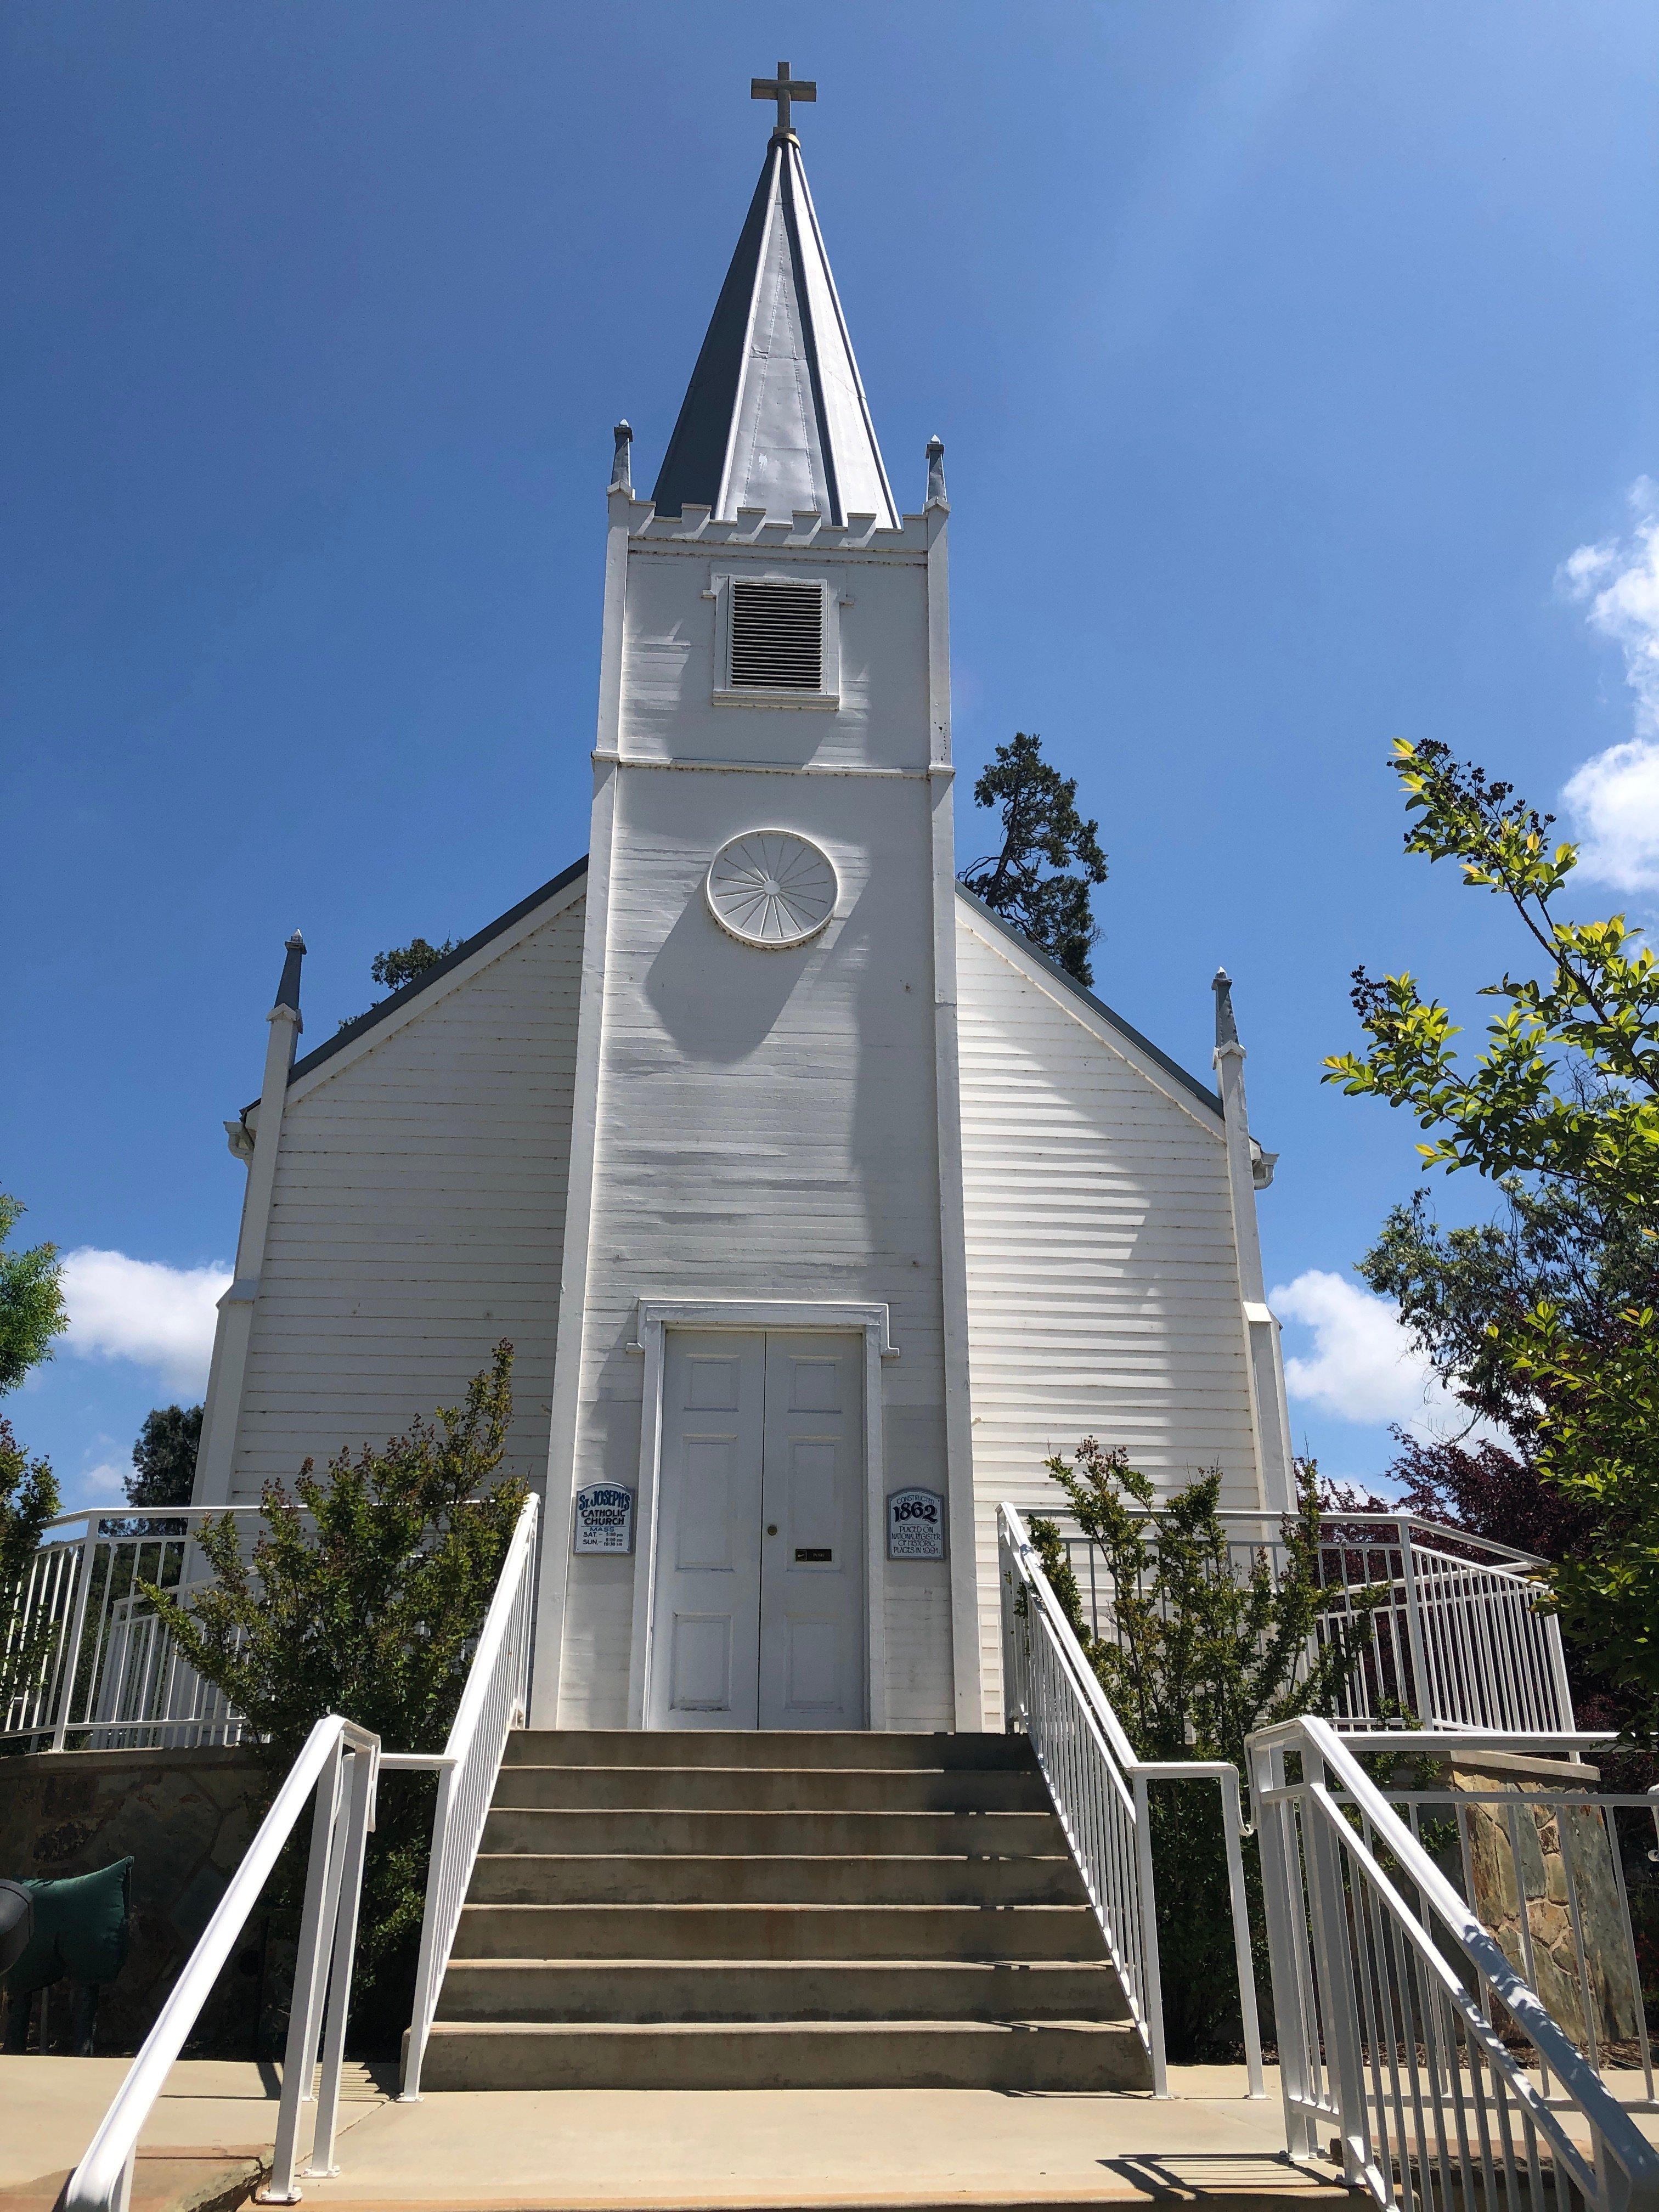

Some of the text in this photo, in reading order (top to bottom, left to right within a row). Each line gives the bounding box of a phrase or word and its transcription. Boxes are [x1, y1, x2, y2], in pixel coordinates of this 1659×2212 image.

[590, 1489, 630, 1511] JOSEPH'S
[896, 1495, 934, 1505] CONSTRUCTED
[581, 1509, 625, 1517] CATHOLIC
[893, 1502, 938, 1523] 1862
